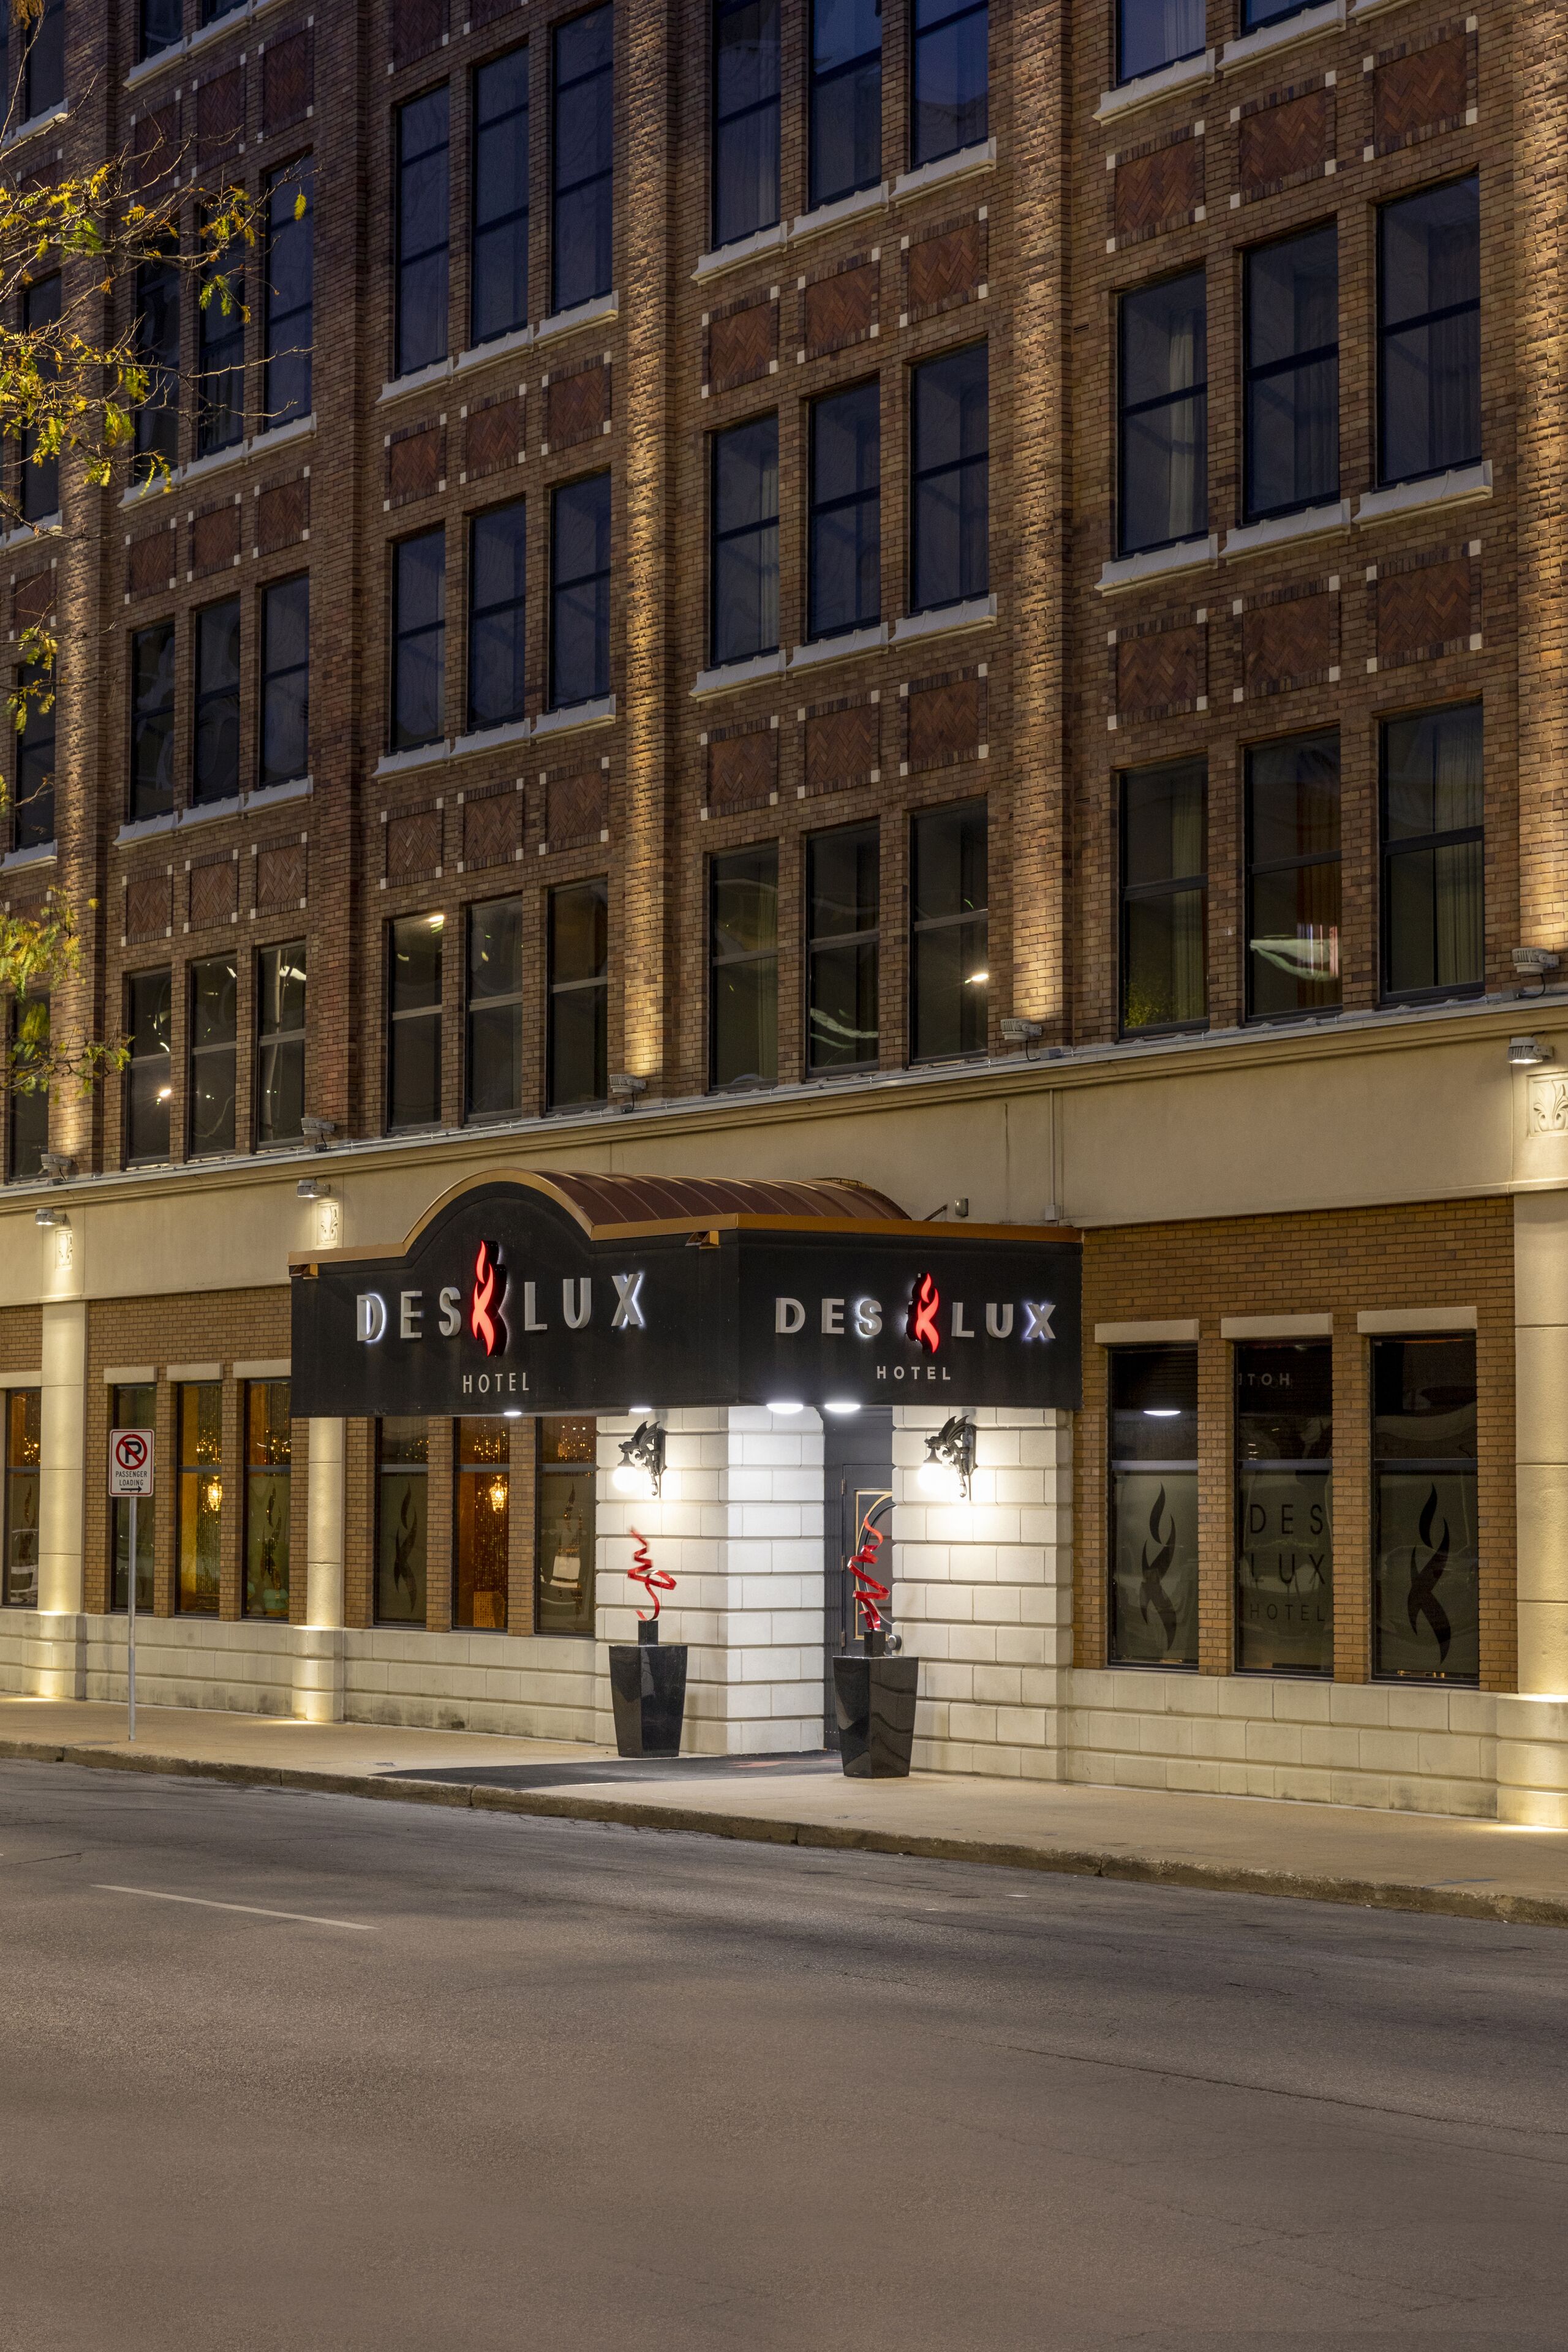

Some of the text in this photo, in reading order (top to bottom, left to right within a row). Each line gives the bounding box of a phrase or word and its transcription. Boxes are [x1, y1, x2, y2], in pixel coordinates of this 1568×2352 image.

[357, 1273, 643, 1341] DES LUX
[775, 1297, 1056, 1340] DES LUX
[463, 1372, 529, 1393] HOTEL
[876, 1366, 951, 1380] HOTEL
[1250, 1504, 1323, 1535] DES
[1251, 1553, 1325, 1585] LUX
[1250, 1603, 1325, 1621] HOTEL
